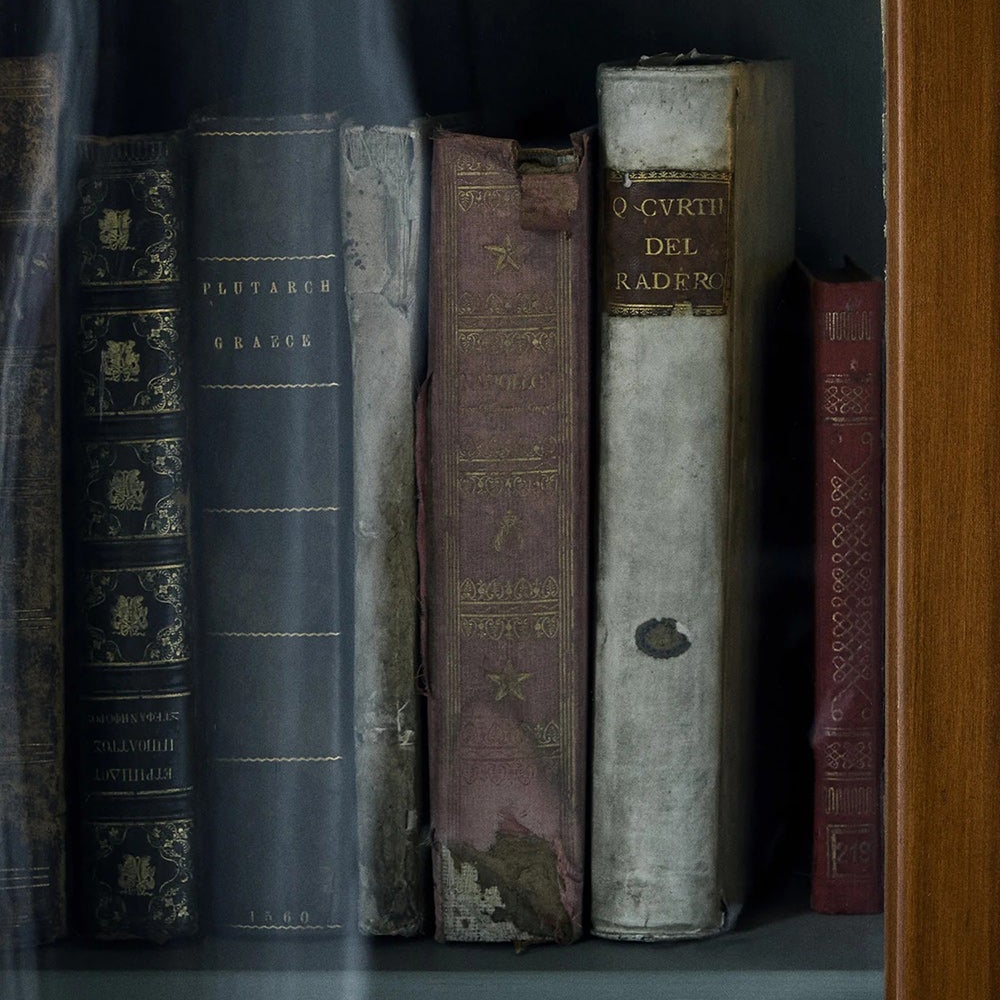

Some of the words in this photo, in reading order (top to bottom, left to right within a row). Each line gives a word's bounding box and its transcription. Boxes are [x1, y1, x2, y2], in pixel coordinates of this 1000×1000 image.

[645, 237, 698, 256] DEL
[201, 279, 331, 296] PLUTARCH
[213, 334, 312, 350] GRAECE
[250, 910, 310, 925] 1560
